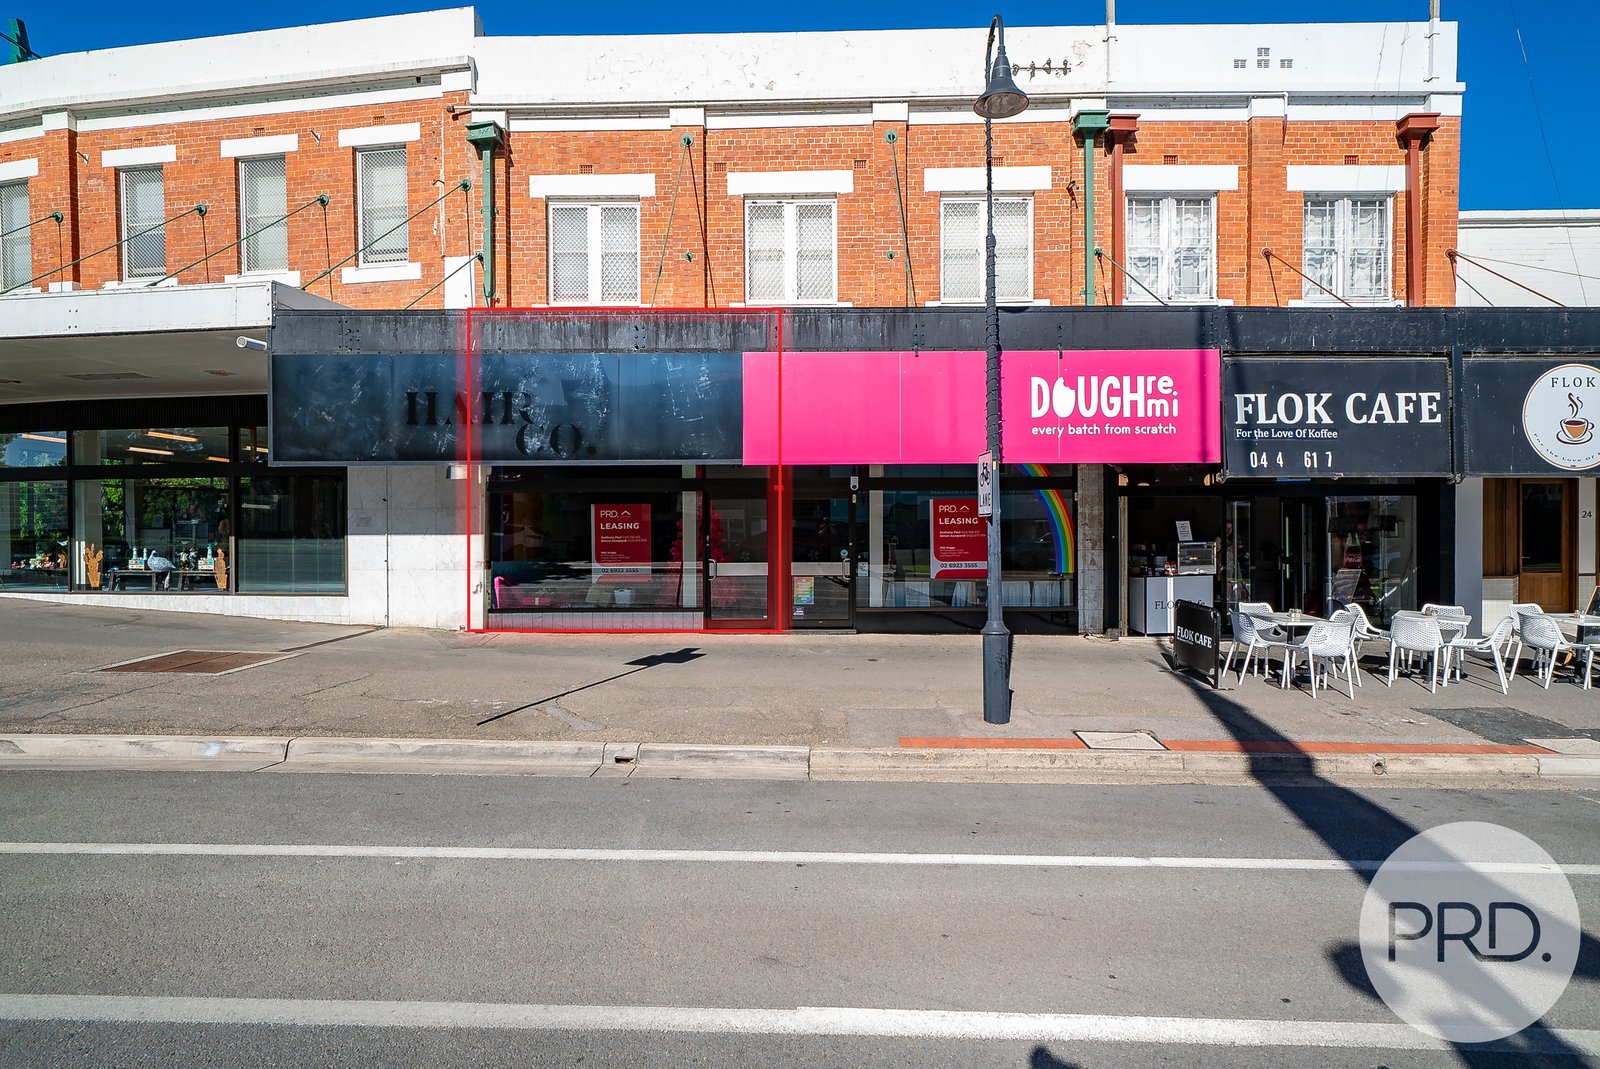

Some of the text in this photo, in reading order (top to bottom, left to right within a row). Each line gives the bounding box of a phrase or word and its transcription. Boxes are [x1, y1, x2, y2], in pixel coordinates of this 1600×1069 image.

[1551, 376, 1596, 388] FLOK
[1031, 375, 1145, 418] DOUGH
[1146, 390, 1179, 418] mi
[405, 391, 535, 425] HAIR
[1234, 392, 1442, 425] FLOK CAFE
[1031, 422, 1177, 439] every batch from scratch
[1236, 428, 1338, 438] For the Love Of Koffee
[979, 492, 991, 508] LANE
[939, 517, 979, 525] LEASING
[1581, 510, 1593, 519] 24
[600, 522, 640, 530] LEASING
[1154, 601, 1175, 610] FLO
[1176, 626, 1194, 642] FLOK
[1194, 633, 1213, 649] CAFE
